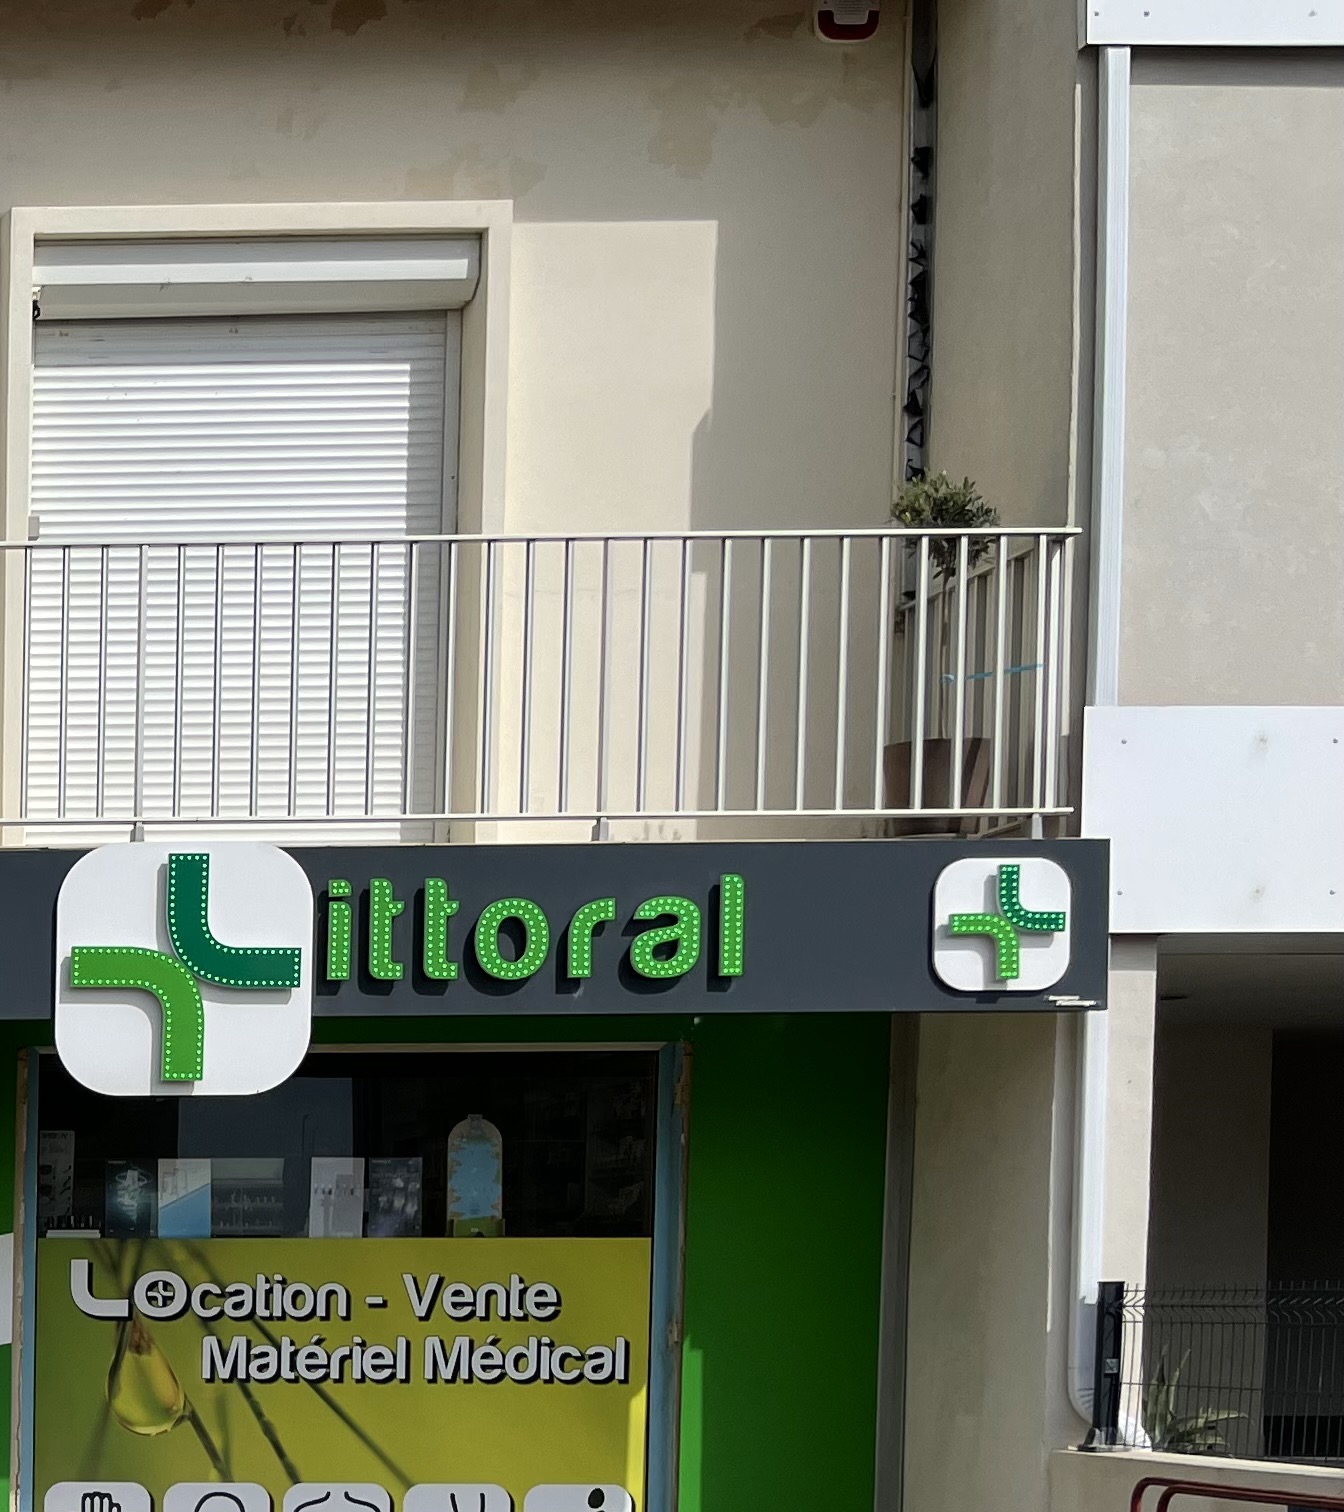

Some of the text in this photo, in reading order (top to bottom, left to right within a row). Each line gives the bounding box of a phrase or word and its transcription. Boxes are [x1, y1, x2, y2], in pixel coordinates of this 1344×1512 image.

[70, 1258, 349, 1321] Location
[401, 1273, 560, 1321] Vente
[202, 1335, 629, 1383] Matériel Médical
